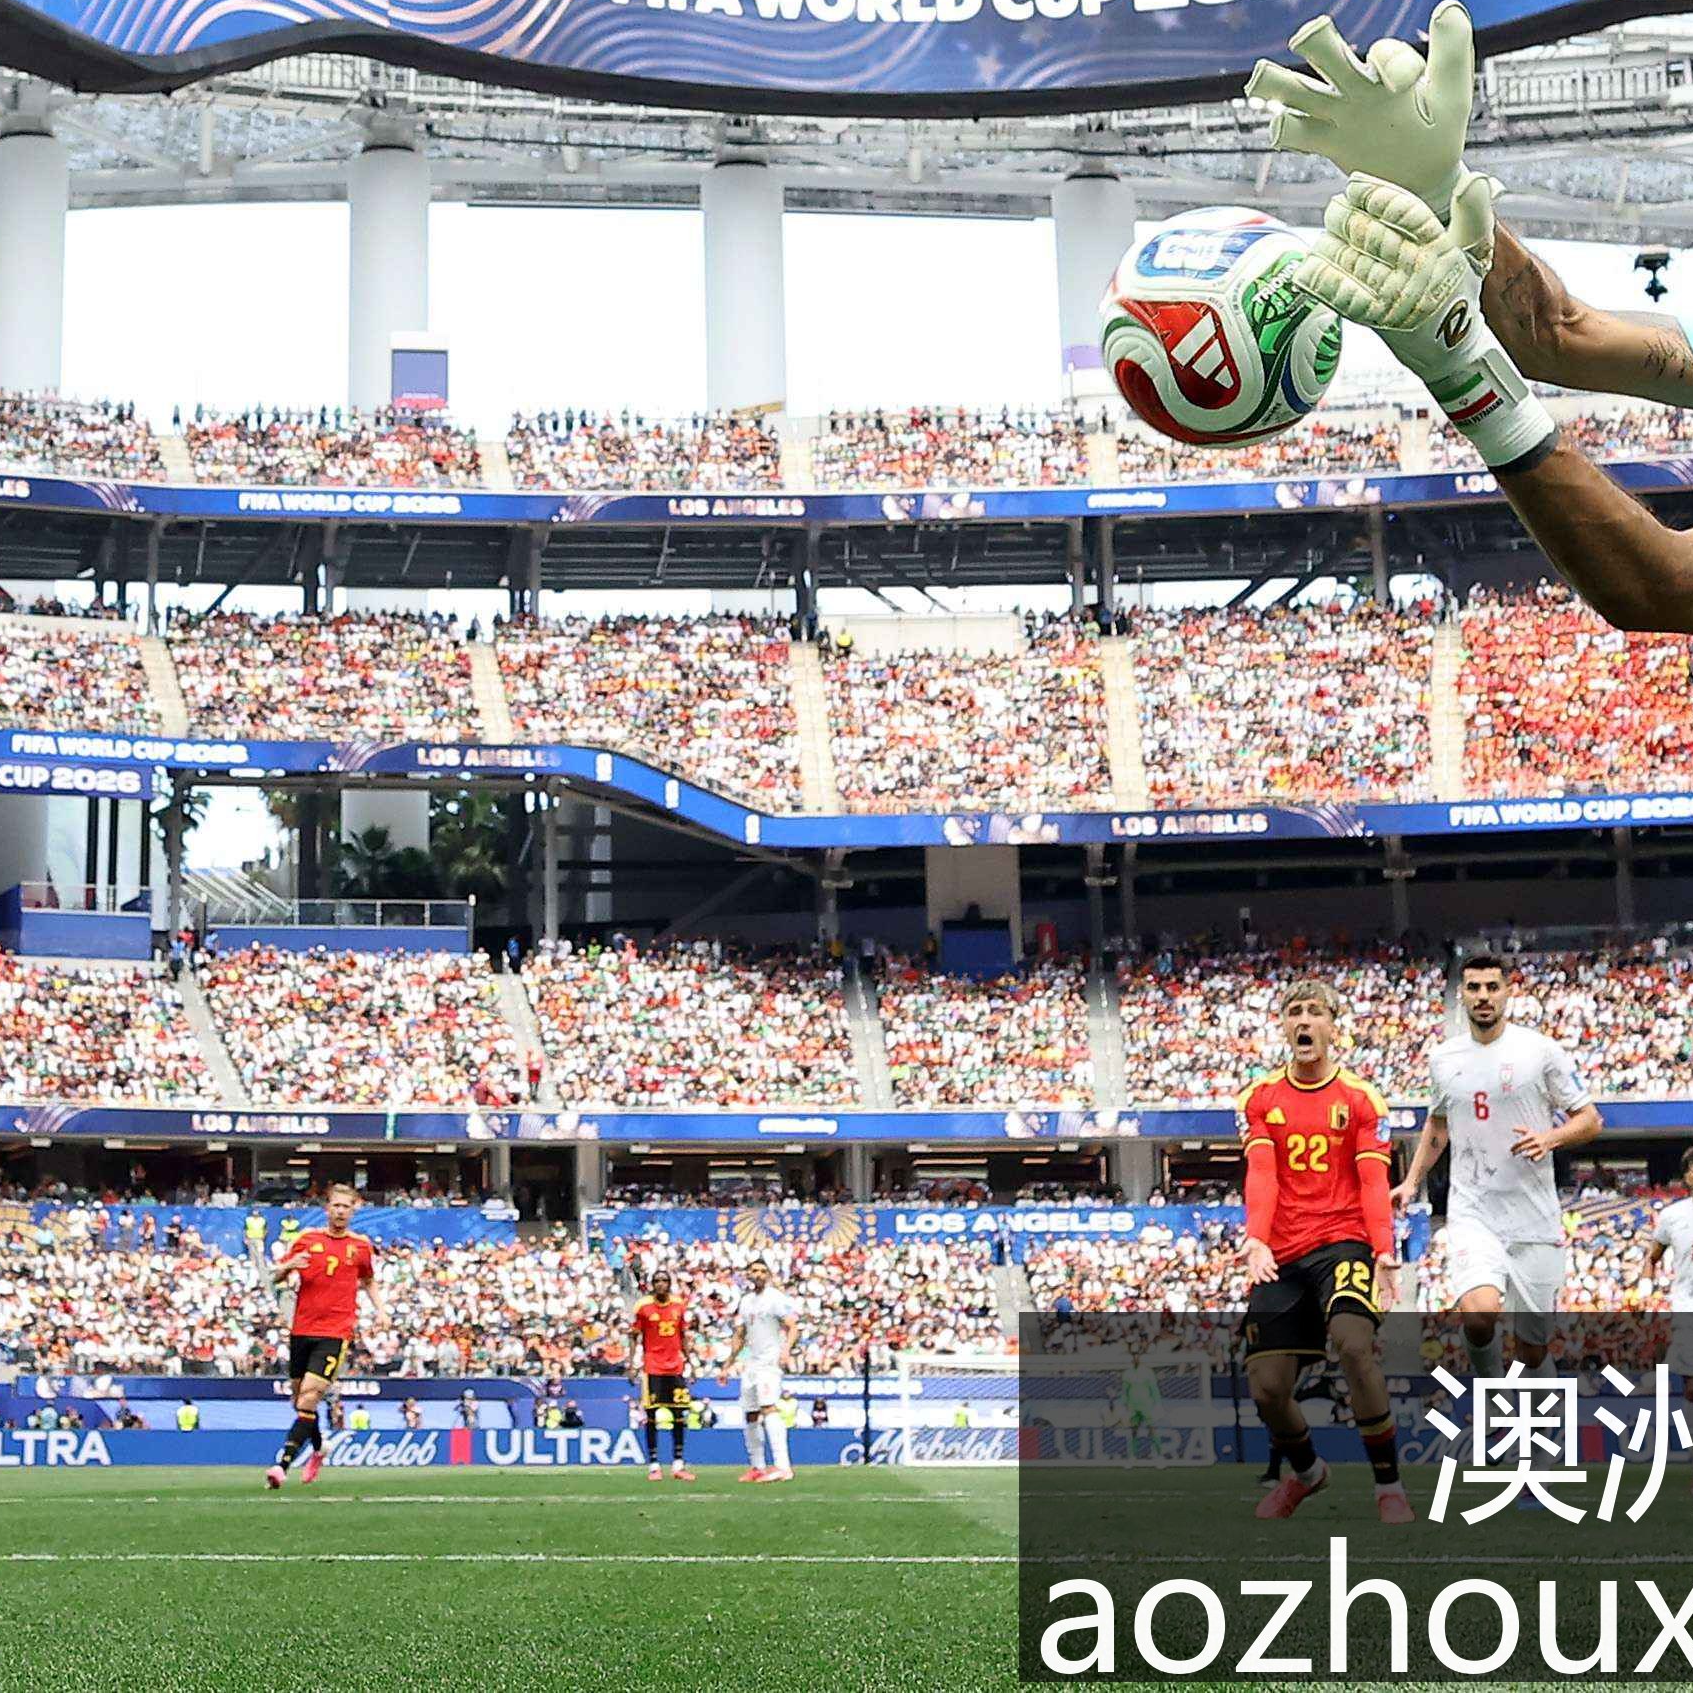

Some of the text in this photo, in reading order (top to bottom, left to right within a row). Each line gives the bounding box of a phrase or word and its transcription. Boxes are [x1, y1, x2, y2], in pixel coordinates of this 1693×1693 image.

[11, 734, 58, 756] FIFA
[59, 736, 133, 760] WORLD
[134, 739, 175, 761] CUP
[51, 766, 142, 794] 2026
[1449, 805, 1499, 826] FIFA
[1500, 802, 1582, 825] WORLD
[1584, 800, 1631, 823] CUP
[1474, 1091, 1489, 1121] 6
[1286, 1133, 1329, 1173] 22
[895, 1211, 1135, 1234] LOS ANGELES
[486, 1429, 646, 1465] ULTRA
